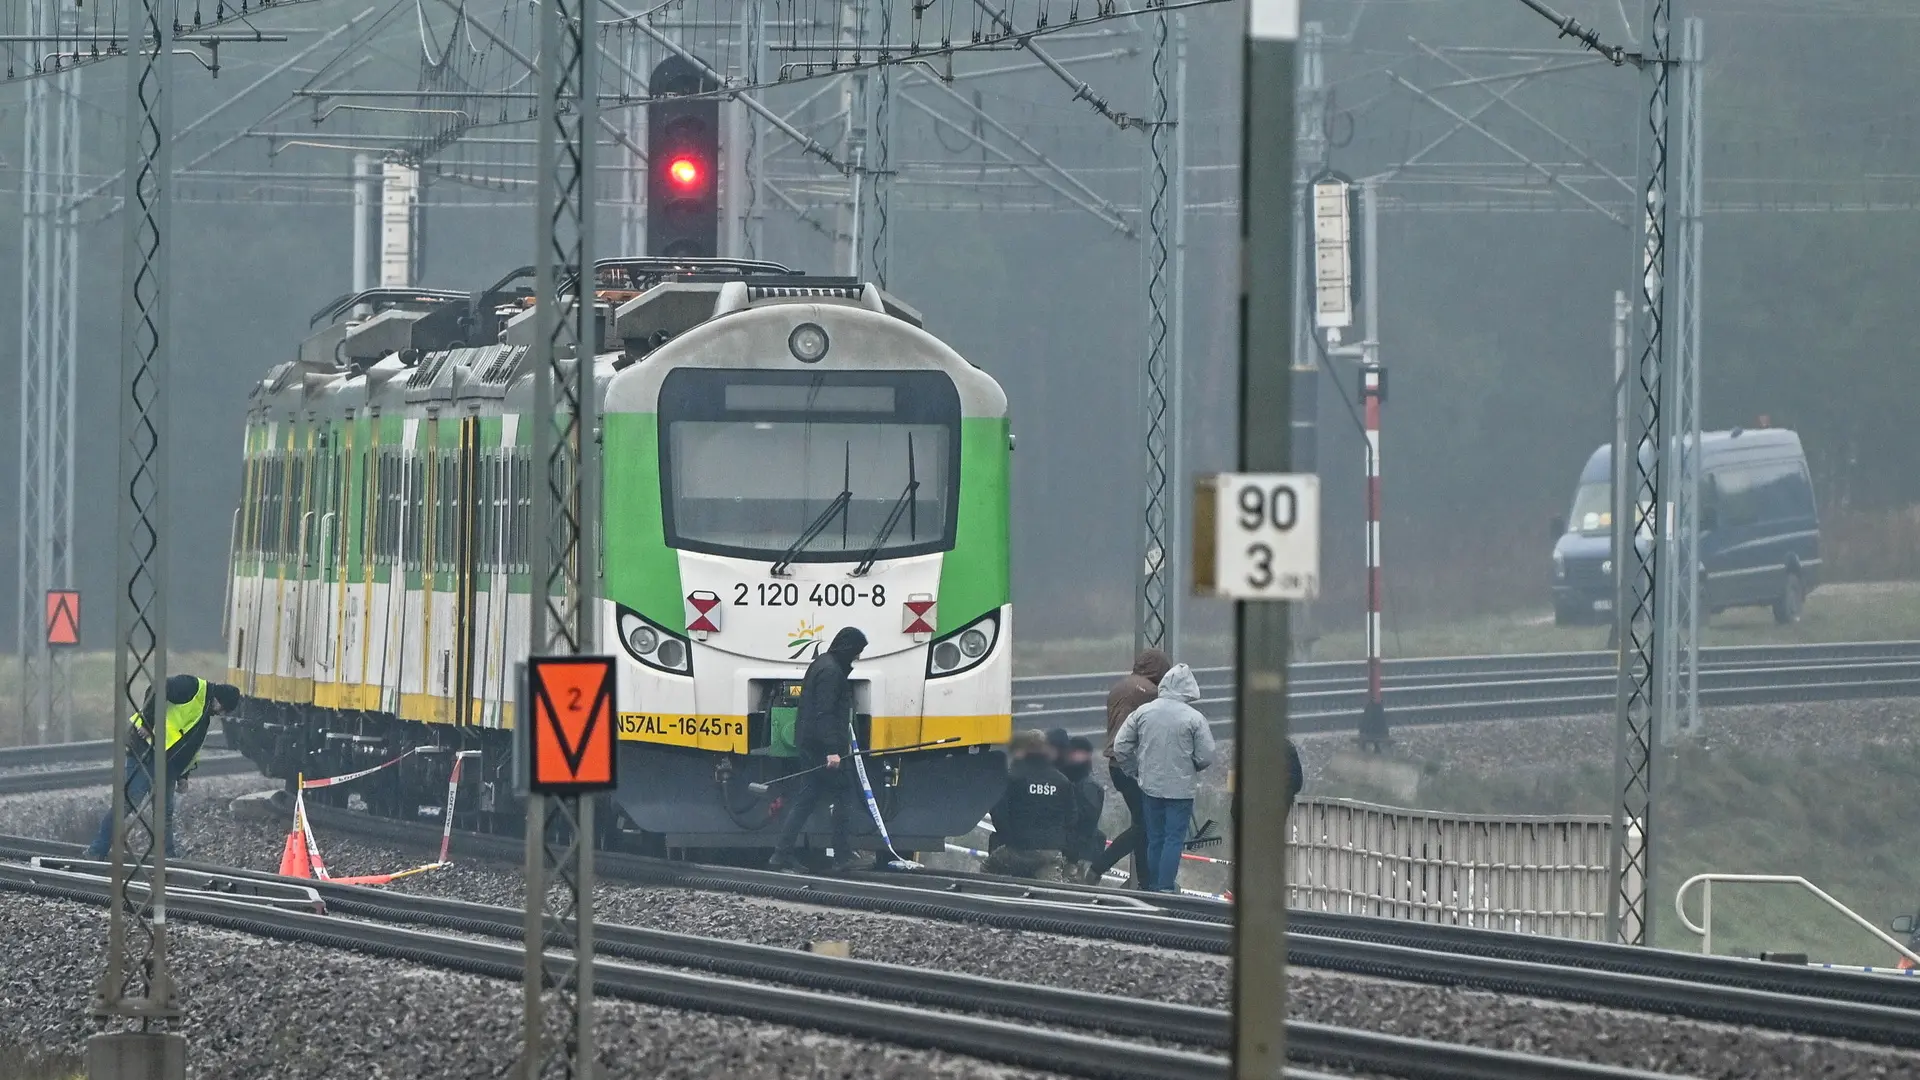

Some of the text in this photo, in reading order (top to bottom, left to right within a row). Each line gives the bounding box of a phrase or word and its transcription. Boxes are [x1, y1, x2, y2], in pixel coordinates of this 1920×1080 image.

[1239, 485, 1297, 531] 90
[1247, 543, 1274, 589] 3
[734, 583, 885, 607] 2 120 400-8
[567, 687, 582, 711] 2
[1029, 782, 1057, 795] CBŚP
